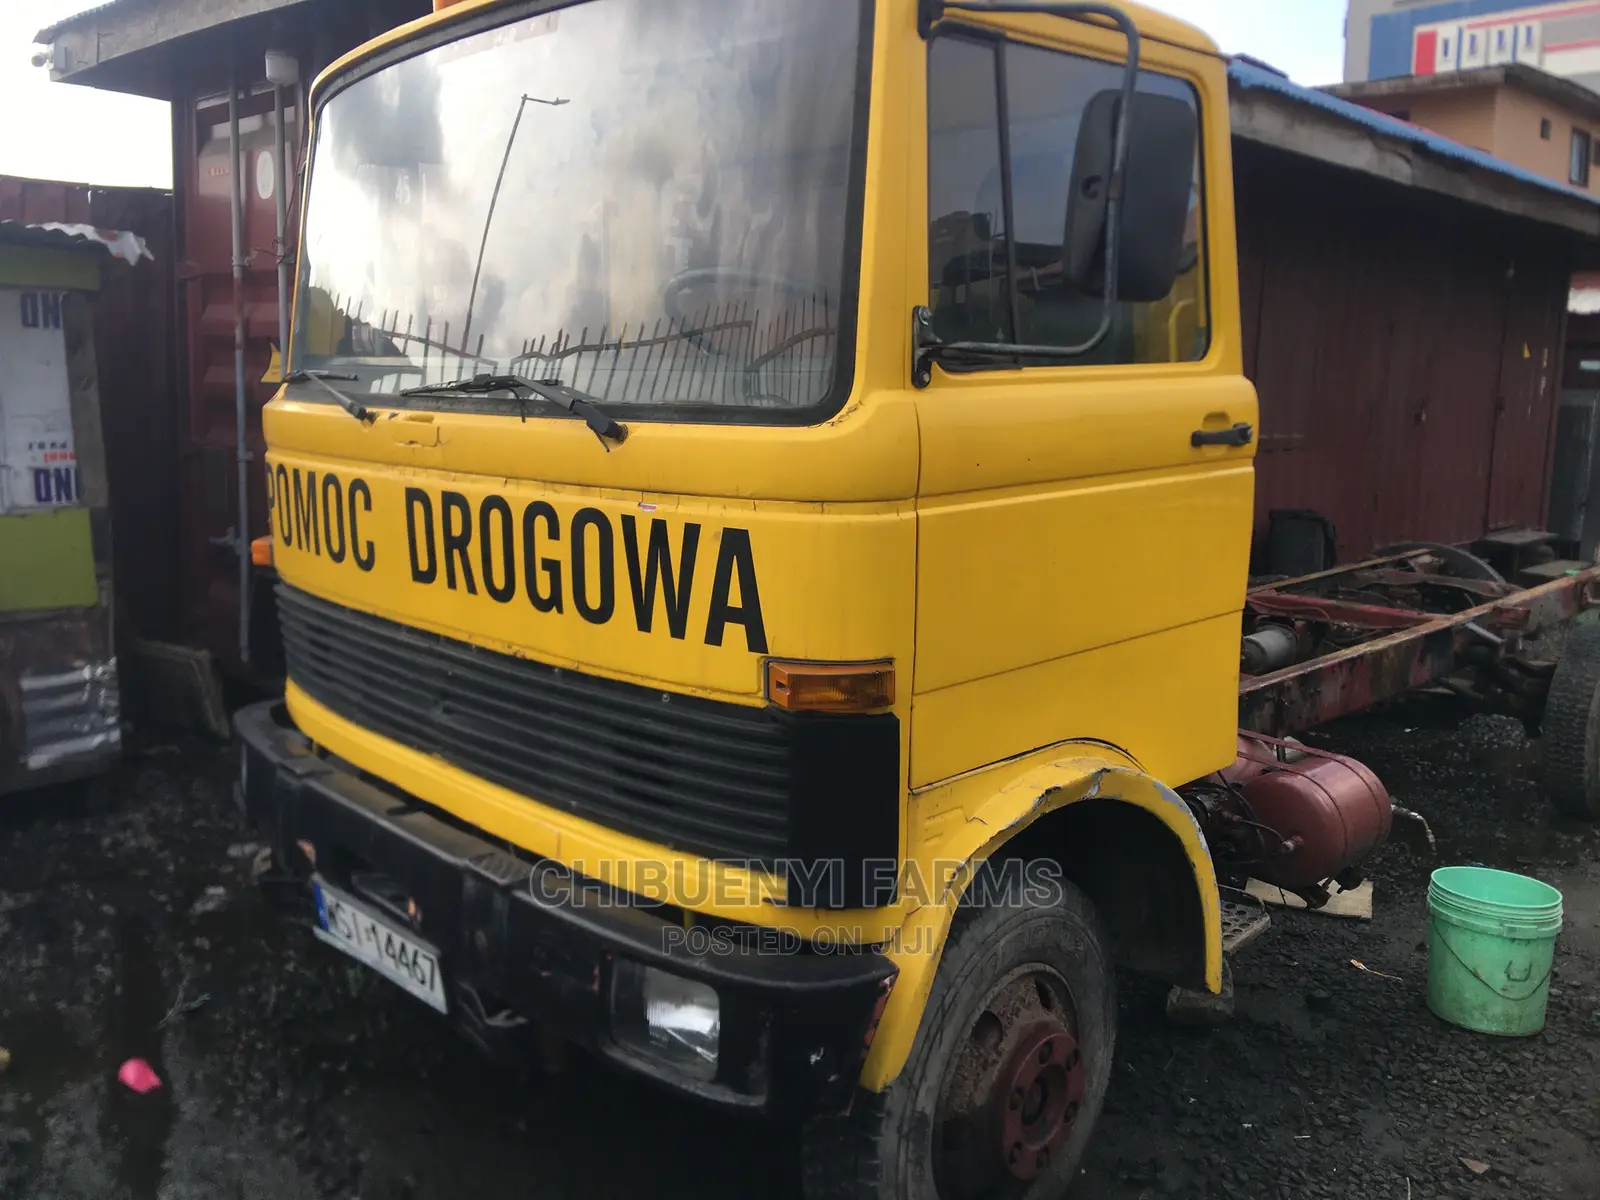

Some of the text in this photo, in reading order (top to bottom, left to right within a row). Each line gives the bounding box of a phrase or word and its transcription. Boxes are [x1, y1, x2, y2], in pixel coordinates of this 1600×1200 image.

[34, 468, 80, 502] ON
[266, 462, 769, 655] POMOC DROGOWA
